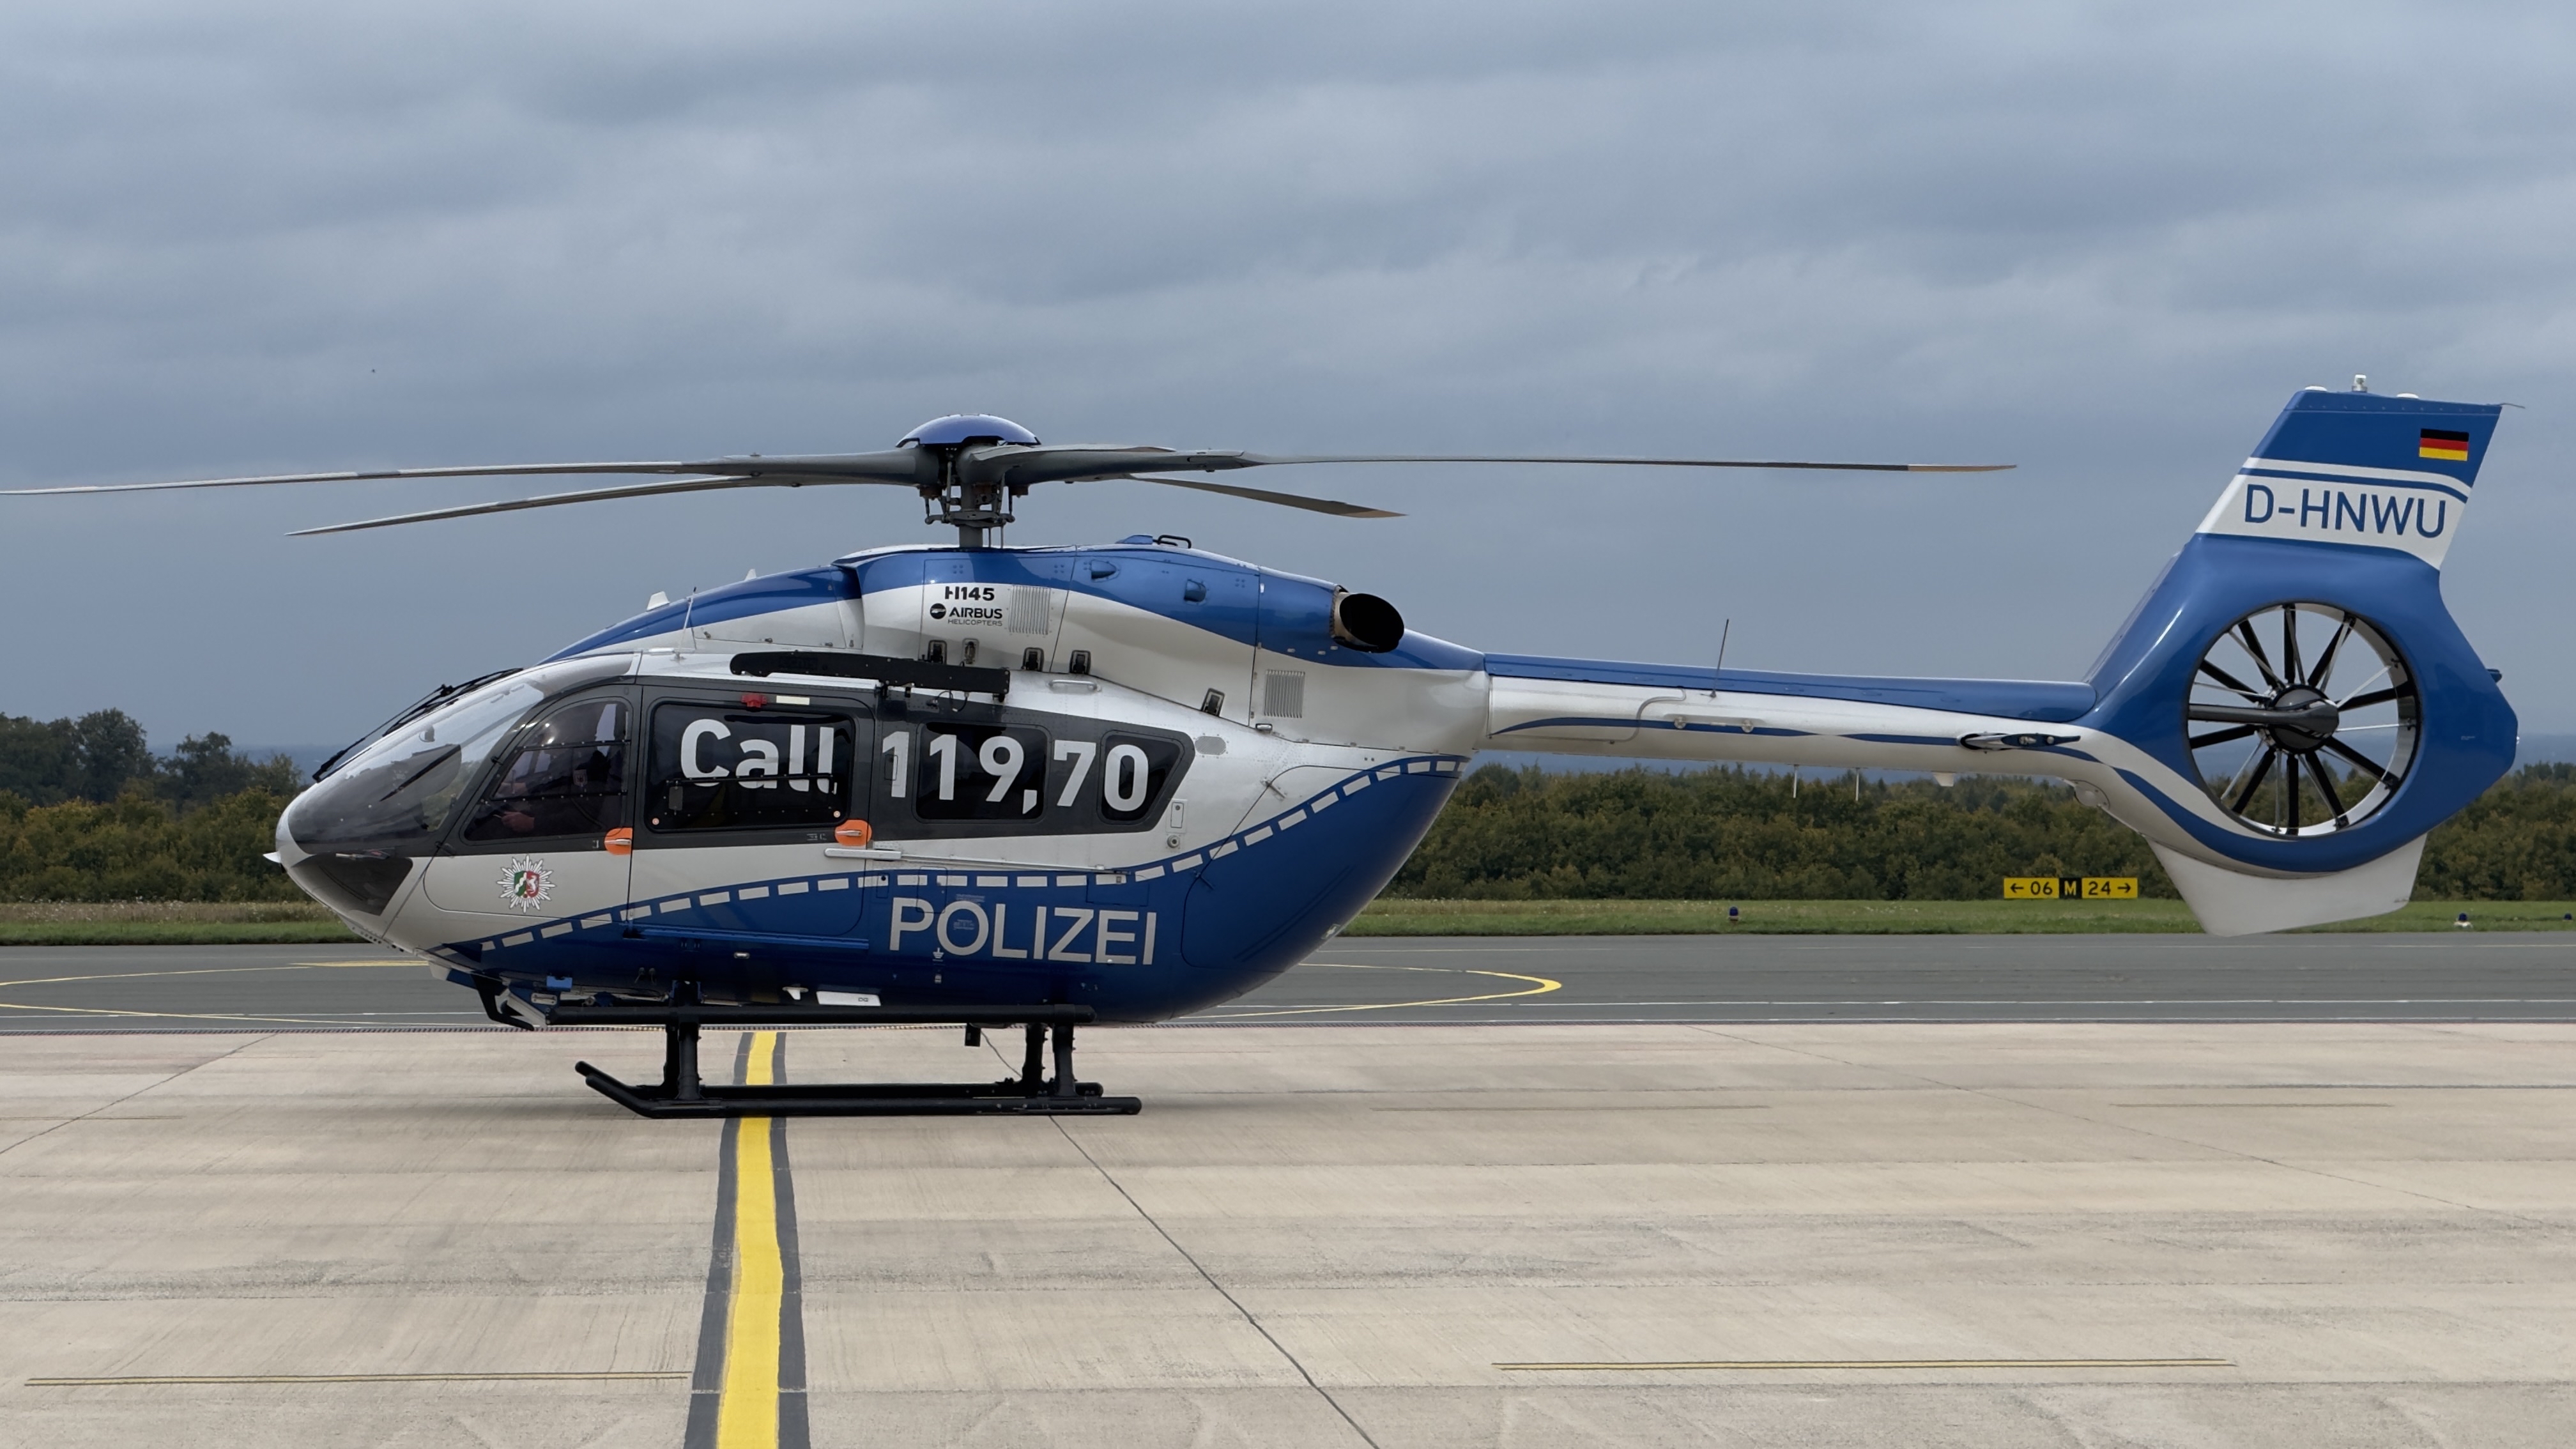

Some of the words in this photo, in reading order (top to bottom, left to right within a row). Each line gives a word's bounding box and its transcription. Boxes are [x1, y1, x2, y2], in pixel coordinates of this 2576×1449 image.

[2244, 484, 2446, 538] D-HNWU
[945, 586, 995, 601] H145
[949, 606, 1003, 619] AIRBUS
[680, 719, 837, 795] Call
[882, 731, 1149, 815] 119,70
[2030, 880, 2053, 896] 06
[2064, 880, 2077, 896] M
[2088, 880, 2111, 896] 24
[889, 897, 1157, 965] POLIZEI
